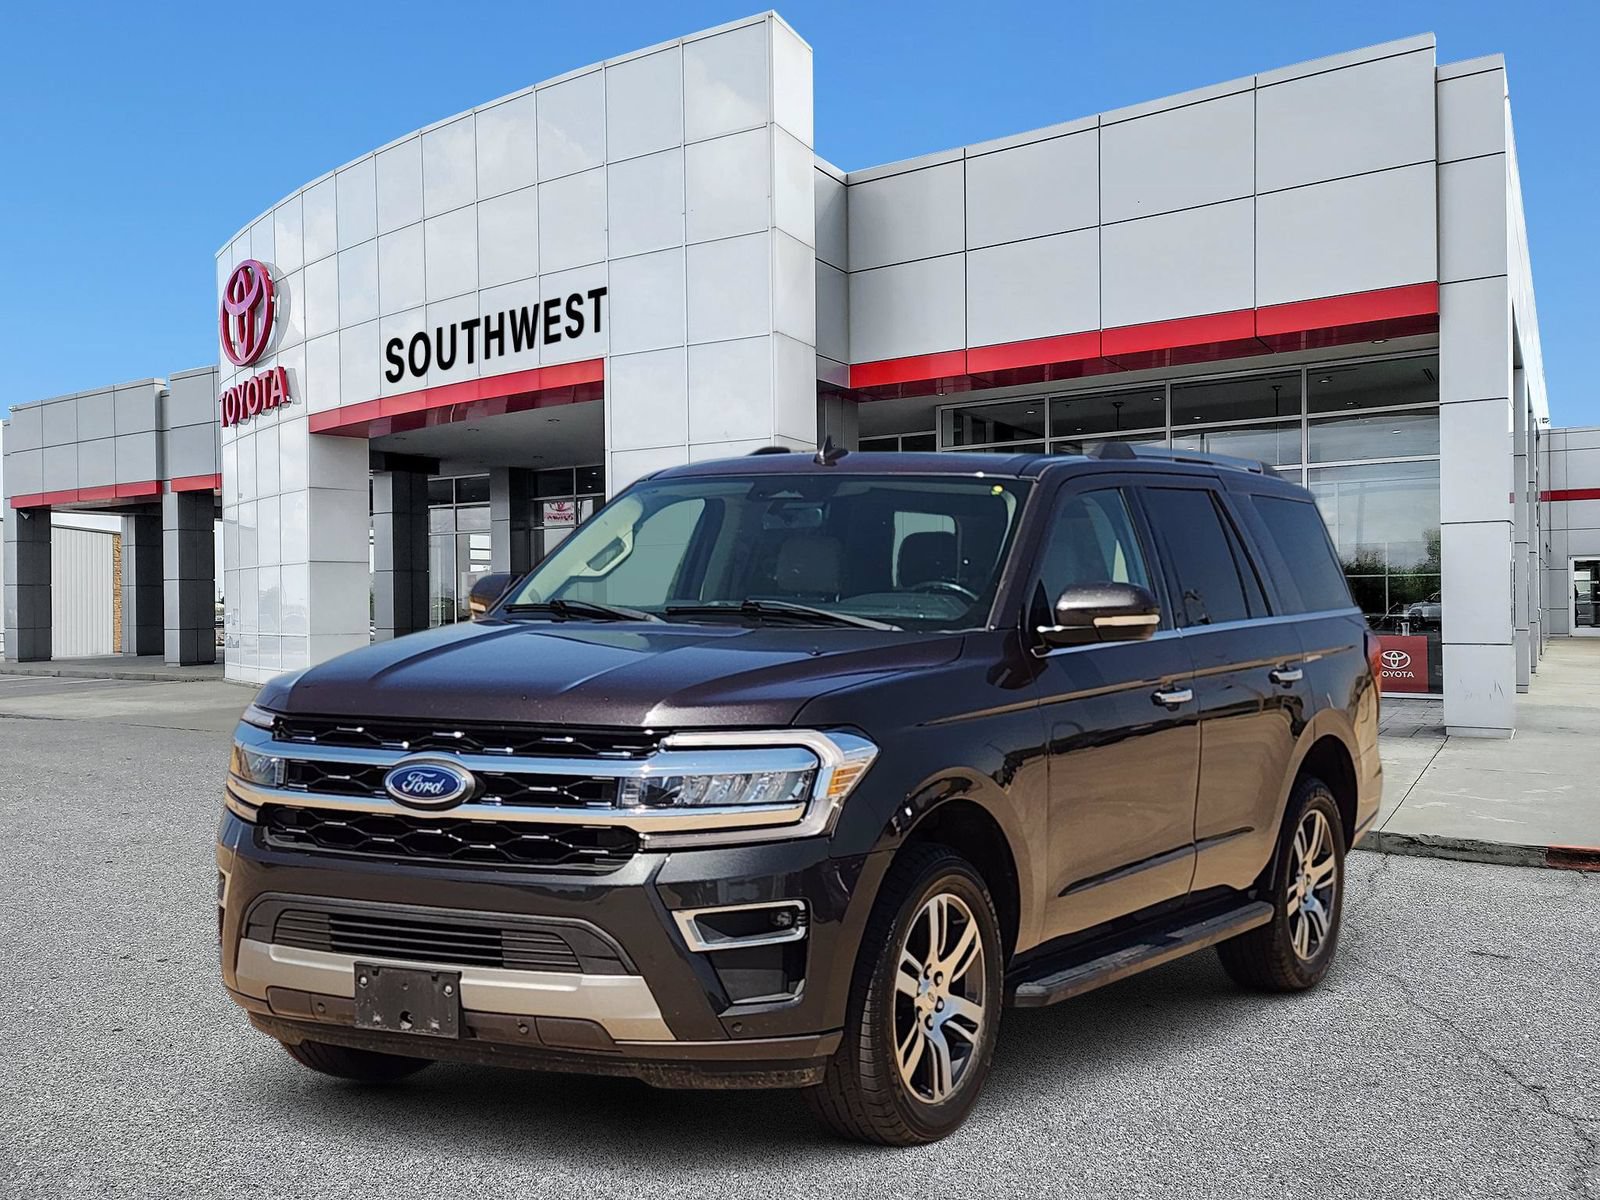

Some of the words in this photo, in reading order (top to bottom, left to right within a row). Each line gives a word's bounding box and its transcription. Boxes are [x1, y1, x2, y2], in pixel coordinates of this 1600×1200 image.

[385, 286, 608, 384] SOUTHWEST
[218, 366, 290, 428] TOYOTA
[1381, 670, 1415, 678] OYOTA
[401, 771, 445, 794] Ford
